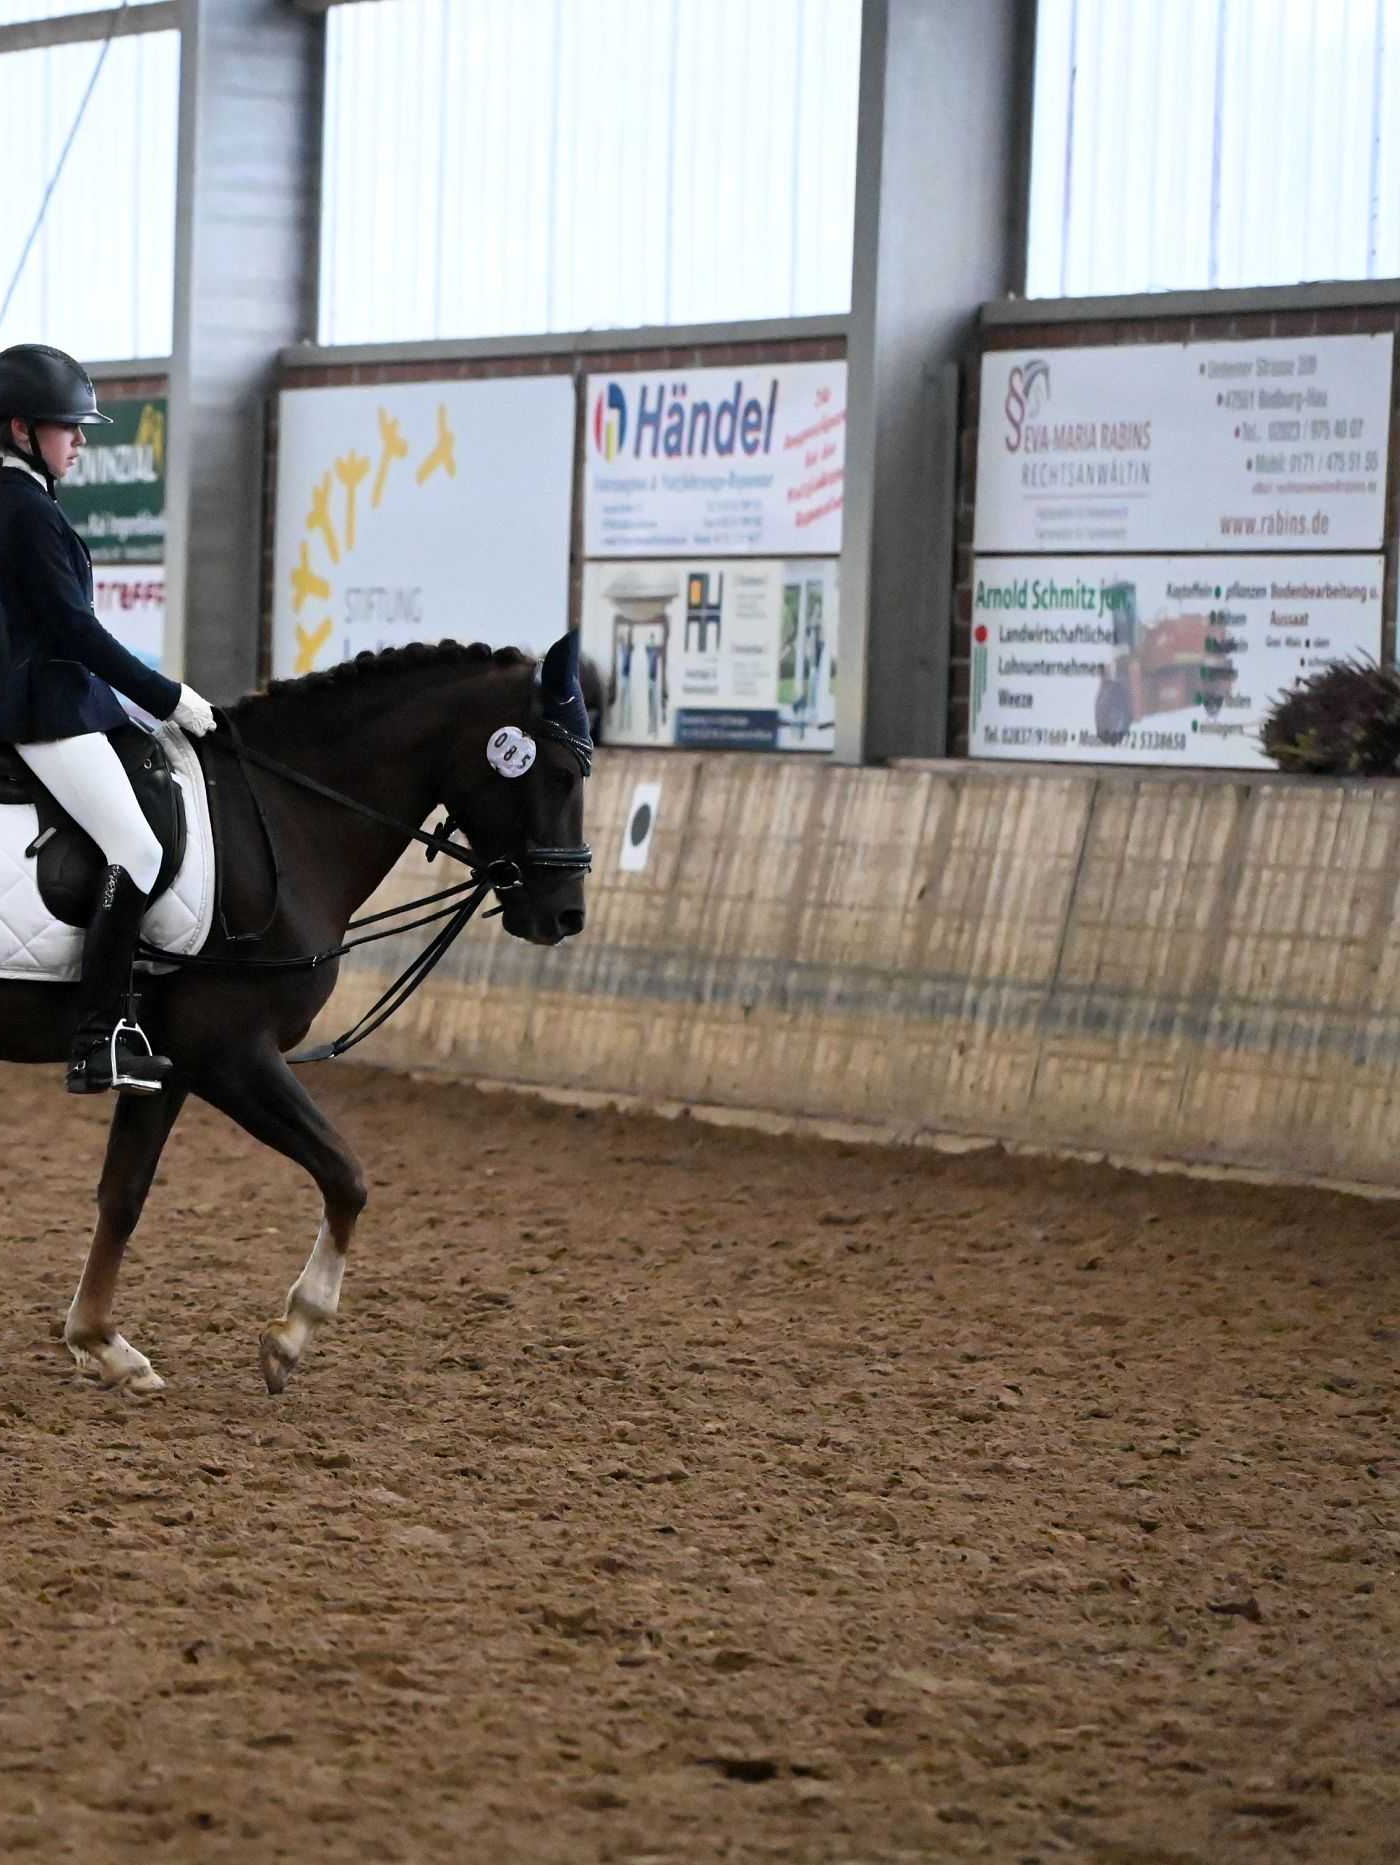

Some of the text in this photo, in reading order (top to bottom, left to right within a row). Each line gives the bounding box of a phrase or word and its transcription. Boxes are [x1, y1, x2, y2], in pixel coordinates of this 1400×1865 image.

[633, 376, 779, 459] Händel
[1219, 508, 1330, 538] www.rabins.de
[975, 579, 1028, 610] Arnold
[1031, 578, 1096, 610] Schmitz
